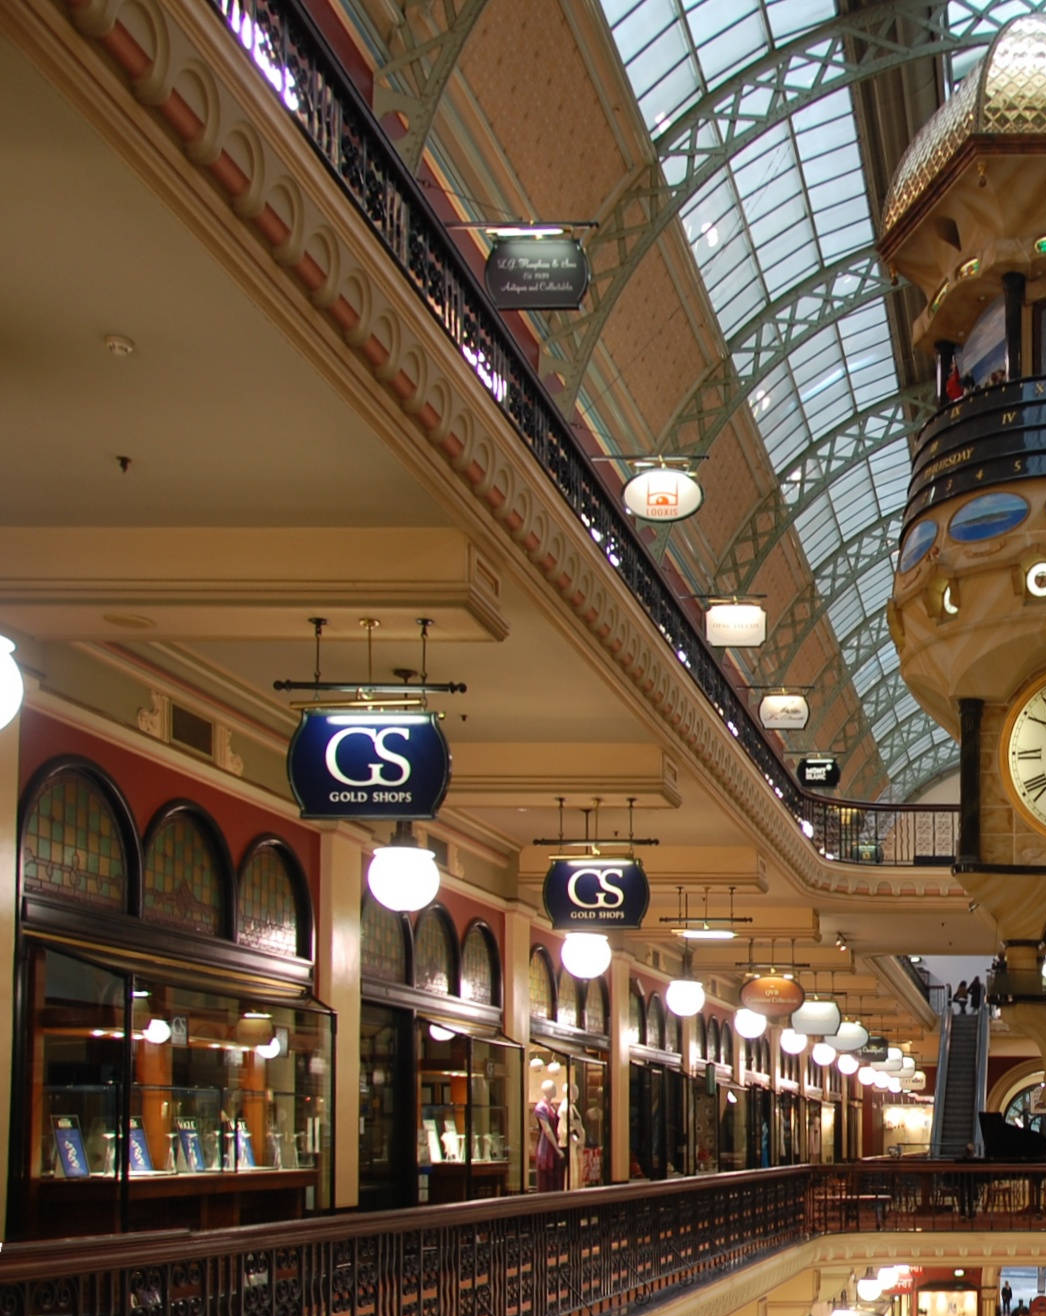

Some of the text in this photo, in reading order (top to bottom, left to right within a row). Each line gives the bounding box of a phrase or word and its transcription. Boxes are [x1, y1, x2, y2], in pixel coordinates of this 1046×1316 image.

[1002, 411, 1017, 425] IV
[976, 469, 984, 480] 4
[1013, 459, 1022, 472] 5
[646, 508, 679, 517] LOOXIS
[325, 726, 411, 787] GS
[329, 792, 412, 803] GOLD SHOPS
[567, 868, 624, 909] GS
[570, 911, 625, 919] GOLD SHOPS
